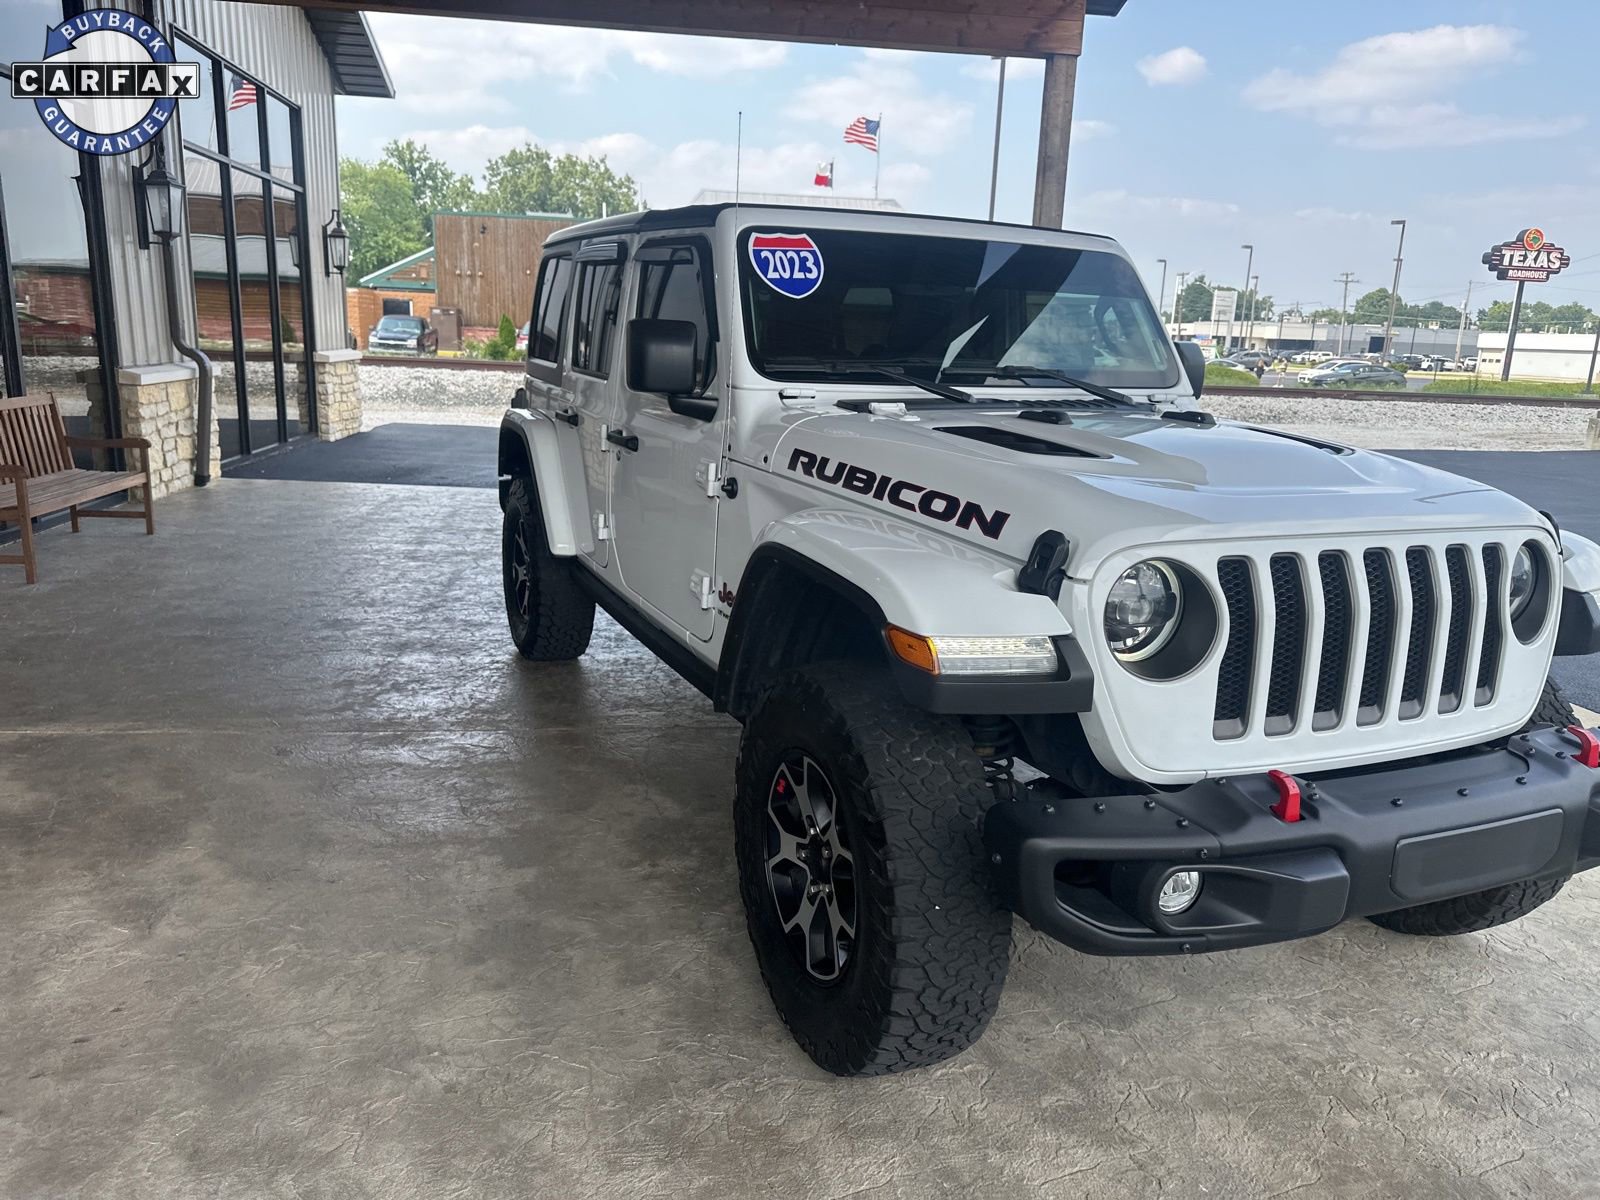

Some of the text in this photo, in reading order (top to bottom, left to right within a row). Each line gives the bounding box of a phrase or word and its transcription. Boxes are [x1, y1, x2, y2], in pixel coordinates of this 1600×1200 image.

[760, 250, 819, 279] 2023
[1501, 249, 1561, 268] TEXAS
[1507, 269, 1548, 279] ROADHOUSE
[787, 448, 1011, 540] RUBICON
